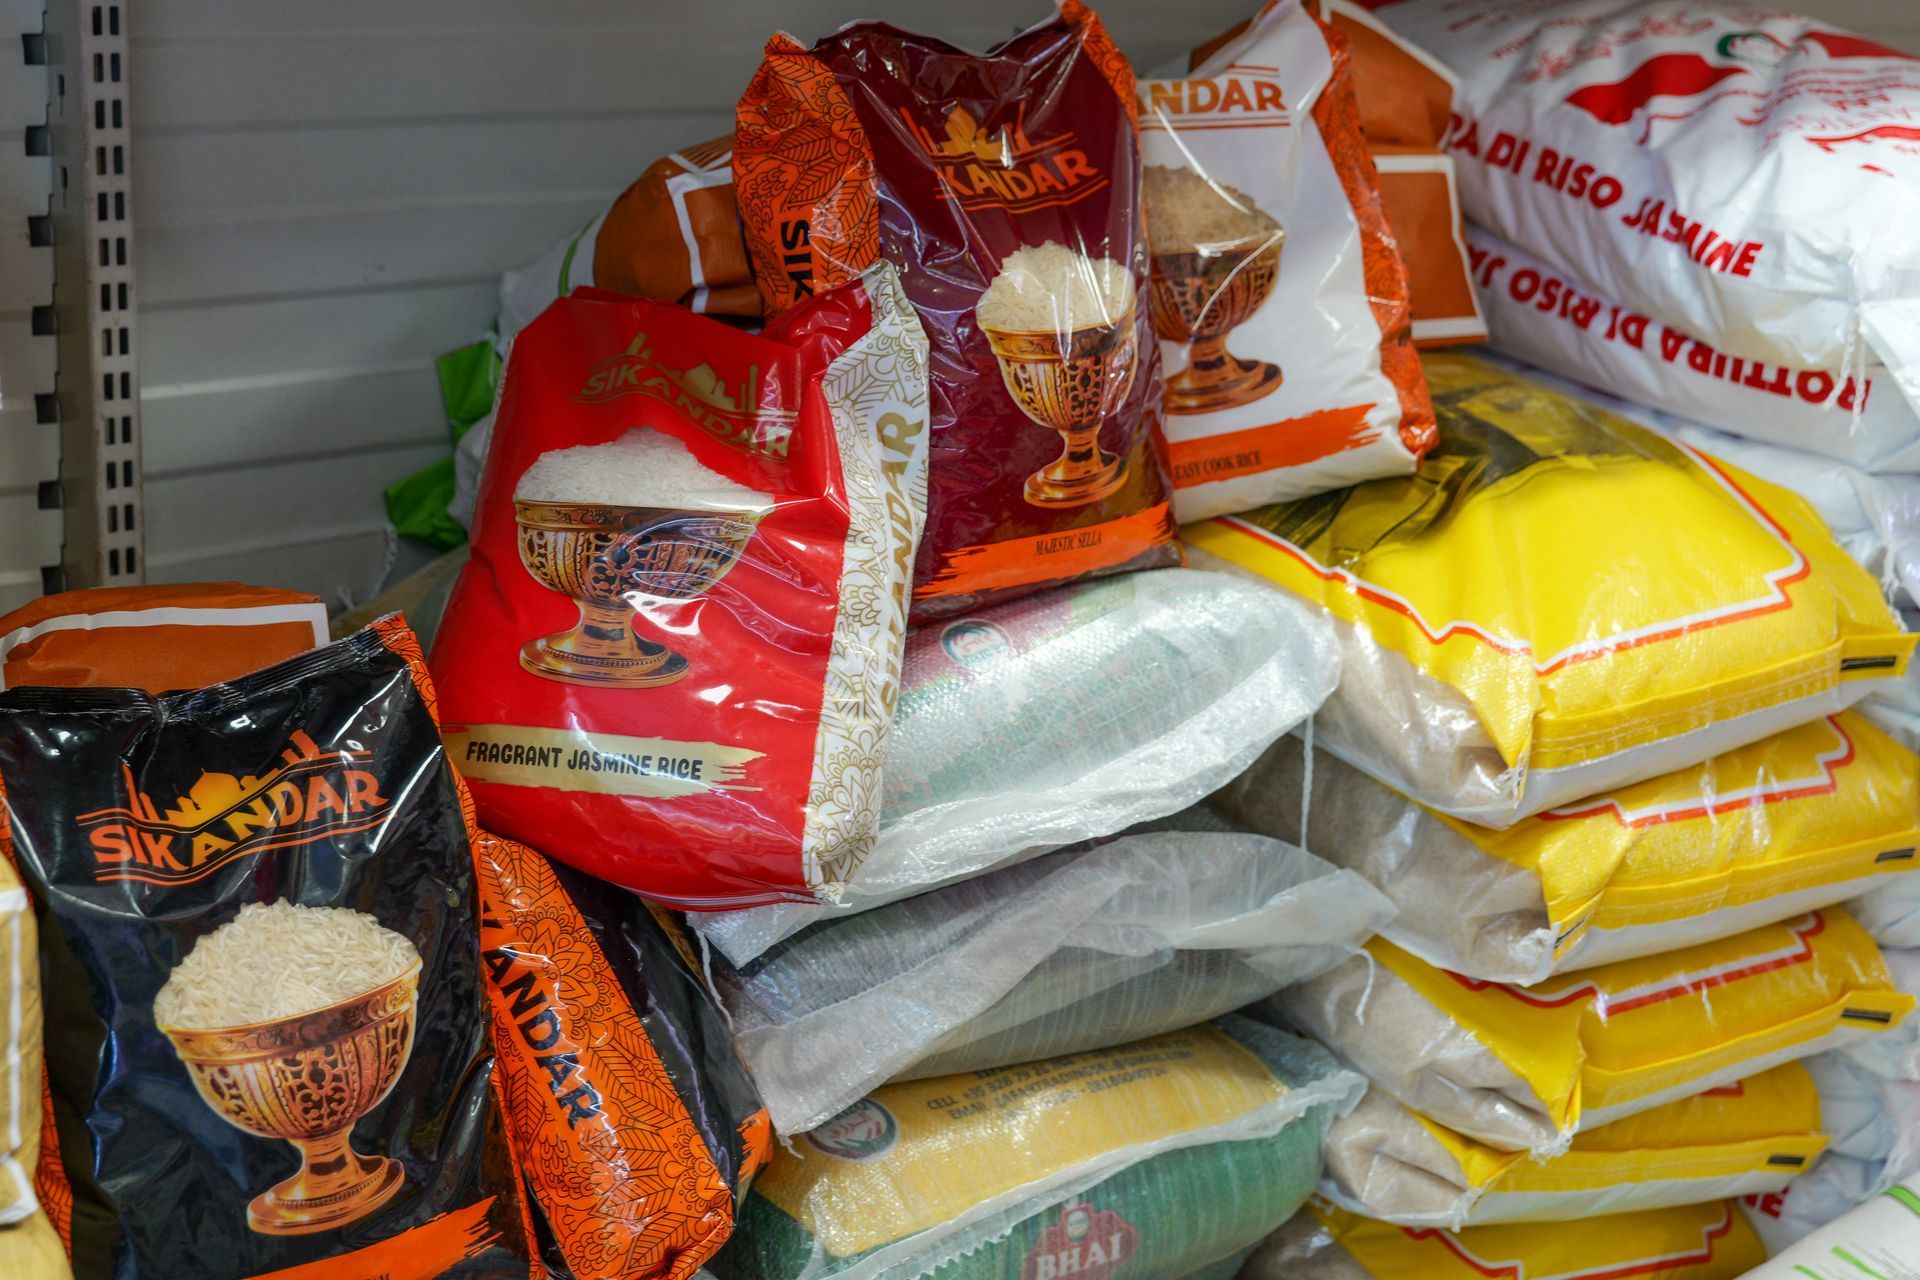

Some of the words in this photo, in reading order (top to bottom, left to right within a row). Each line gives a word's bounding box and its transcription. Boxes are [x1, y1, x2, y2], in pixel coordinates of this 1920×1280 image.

[1485, 131, 1530, 175] DI
[1533, 147, 1623, 208] RISO
[1621, 198, 1764, 277] JASMINE
[1509, 268, 1600, 331] RISO
[1606, 307, 1651, 350] DI
[580, 363, 793, 456] SIKANDAR
[1174, 462, 1200, 480] EASY
[1203, 455, 1234, 474] COOK
[1236, 450, 1262, 468] RICE
[1035, 534, 1076, 555] MAJESTIC
[466, 741, 563, 769] FRAGRANT
[567, 749, 653, 777] JASMINE
[656, 756, 704, 781] RICE
[89, 770, 389, 871] SIKANDAR
[926, 1094, 957, 1110] CELL
[1036, 1232, 1123, 1280] BHAI
